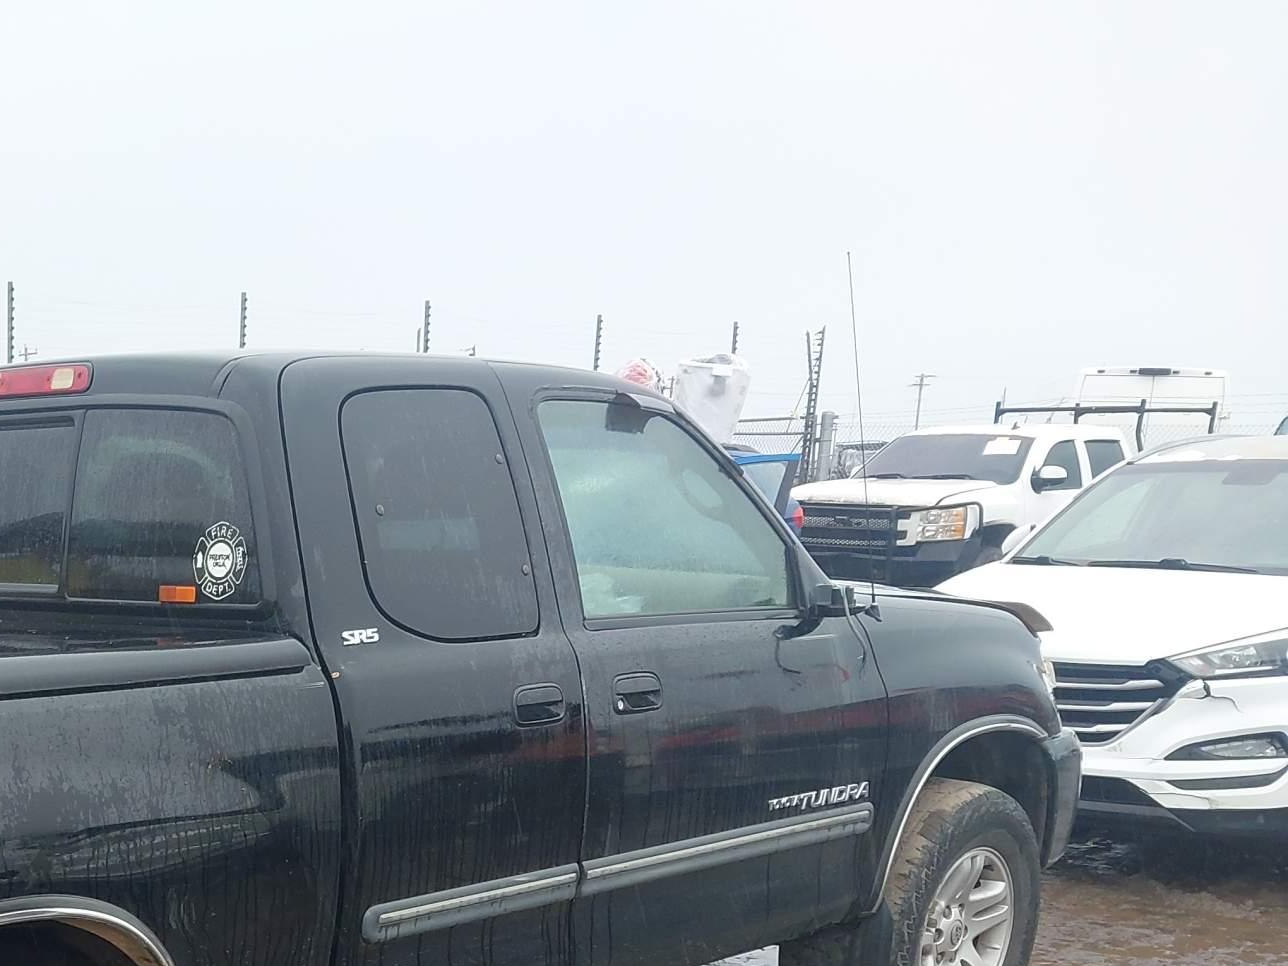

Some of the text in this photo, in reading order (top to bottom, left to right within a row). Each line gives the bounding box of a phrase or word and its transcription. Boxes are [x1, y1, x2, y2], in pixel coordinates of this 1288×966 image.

[211, 525, 234, 539] FIRE
[206, 582, 232, 596] DEPT.
[342, 627, 379, 646] SR5
[799, 781, 870, 810] TUNDRA
